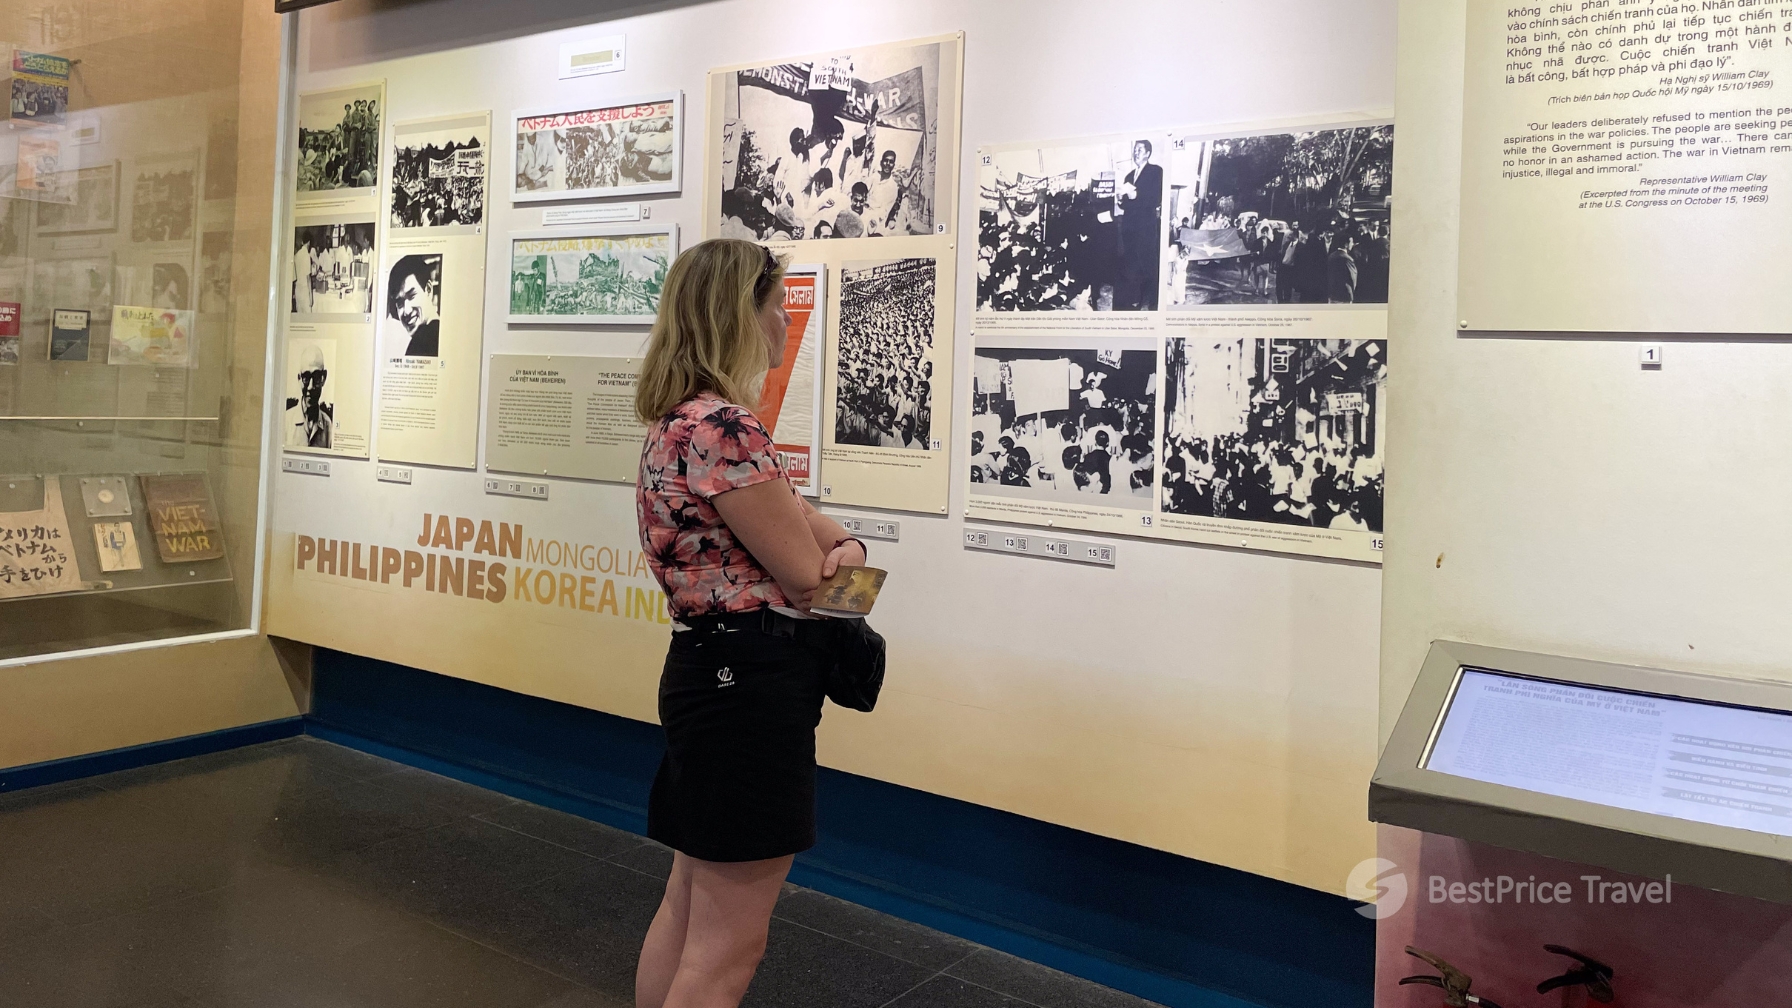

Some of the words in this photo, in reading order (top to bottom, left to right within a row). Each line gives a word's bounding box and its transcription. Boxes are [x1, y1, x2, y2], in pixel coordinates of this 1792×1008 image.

[1508, 7, 1541, 18] không
[1550, 3, 1572, 13] chịu
[1508, 21, 1526, 31] vào
[1529, 18, 1559, 29] chính
[1562, 15, 1588, 25] sách
[1591, 10, 1621, 23] chiến
[1625, 7, 1653, 18] tranh
[1657, 5, 1677, 15] của
[1681, 4, 1699, 14] họ.
[1534, 31, 1560, 42] bình,
[1568, 29, 1588, 38] còn
[1595, 24, 1626, 36] chính
[1634, 21, 1655, 33] phủ
[1663, 18, 1676, 30] lại
[1684, 15, 1705, 27] tiếp
[1713, 14, 1731, 25] tục
[1739, 8, 1772, 21] chiến
[1506, 47, 1542, 58] Không
[1572, 42, 1592, 52] nào
[1598, 39, 1612, 49] có
[1619, 36, 1648, 46] danh
[1655, 34, 1671, 44] dự
[1678, 32, 1708, 41] trong
[1716, 27, 1738, 38] một
[1745, 24, 1776, 35] hành
[1506, 61, 1532, 72] nhục
[1620, 49, 1651, 61] Cuộc
[1663, 44, 1694, 56] chiến
[1708, 42, 1738, 52] tranh
[1748, 39, 1772, 50] Việt
[1506, 74, 1514, 84] là
[1518, 72, 1535, 83] bất
[1538, 72, 1568, 82] công,
[1572, 67, 1589, 79] bất
[1593, 67, 1615, 78] hợp
[1619, 64, 1648, 76] pháp
[1651, 61, 1665, 71] và
[1669, 60, 1686, 72] phi
[1690, 59, 1713, 70] đạo
[1712, 72, 1745, 81] William
[1748, 70, 1770, 80] Clay
[815, 74, 849, 87] VIETNAM
[1691, 84, 1714, 95] ngày
[1718, 80, 1773, 92] 15/10/1969)
[1552, 120, 1587, 129] leaders
[1591, 116, 1648, 127] deliberately
[1653, 112, 1690, 123] refused
[1709, 110, 1751, 119] mention
[1756, 108, 1772, 116] the
[1504, 134, 1554, 145] aspirations
[1570, 132, 1584, 140] the
[1588, 131, 1605, 139] war
[1608, 128, 1648, 139] policies.
[1652, 126, 1671, 135] The
[1675, 124, 1710, 135] people
[1734, 120, 1776, 130] seeking
[1174, 140, 1184, 148] 14
[1504, 146, 1526, 155] while
[1552, 142, 1611, 153] Government
[1630, 138, 1674, 150] pursuing
[1737, 133, 1768, 142] There
[1577, 153, 1622, 162] ashamed
[1626, 152, 1659, 160] action.
[1662, 150, 1682, 158] The
[1709, 148, 1718, 156] in
[1722, 145, 1766, 155] Vietnam
[1503, 168, 1542, 179] injustice,
[1546, 167, 1573, 177] illegal
[1576, 165, 1594, 174] and
[1640, 176, 1707, 186] Representative
[1710, 174, 1743, 182] William
[1746, 173, 1767, 182] Clay
[1580, 190, 1627, 199] (Excerpted
[1629, 188, 1650, 197] from
[1668, 186, 1699, 195] minute
[1730, 184, 1768, 193] meeting
[1605, 200, 1622, 208] U.S.
[1625, 200, 1668, 208] Congress
[1685, 197, 1722, 205] October
[1725, 196, 1738, 204] 15,
[1743, 195, 1768, 204] 1969)
[938, 224, 944, 233] 9
[1646, 349, 1653, 360] 1
[932, 440, 940, 448] 11
[157, 505, 205, 521] VIET-
[0, 525, 61, 542] メリカは
[162, 520, 206, 536] NAM
[165, 536, 211, 552] WAR
[417, 513, 523, 560] JAPAN
[526, 538, 648, 579] MONGOLIA
[1372, 539, 1383, 548] 15
[42, 553, 67, 564] から
[0, 564, 63, 583] 手をひけ
[297, 534, 507, 604] PHILIPPINES
[514, 567, 619, 616] KOREA
